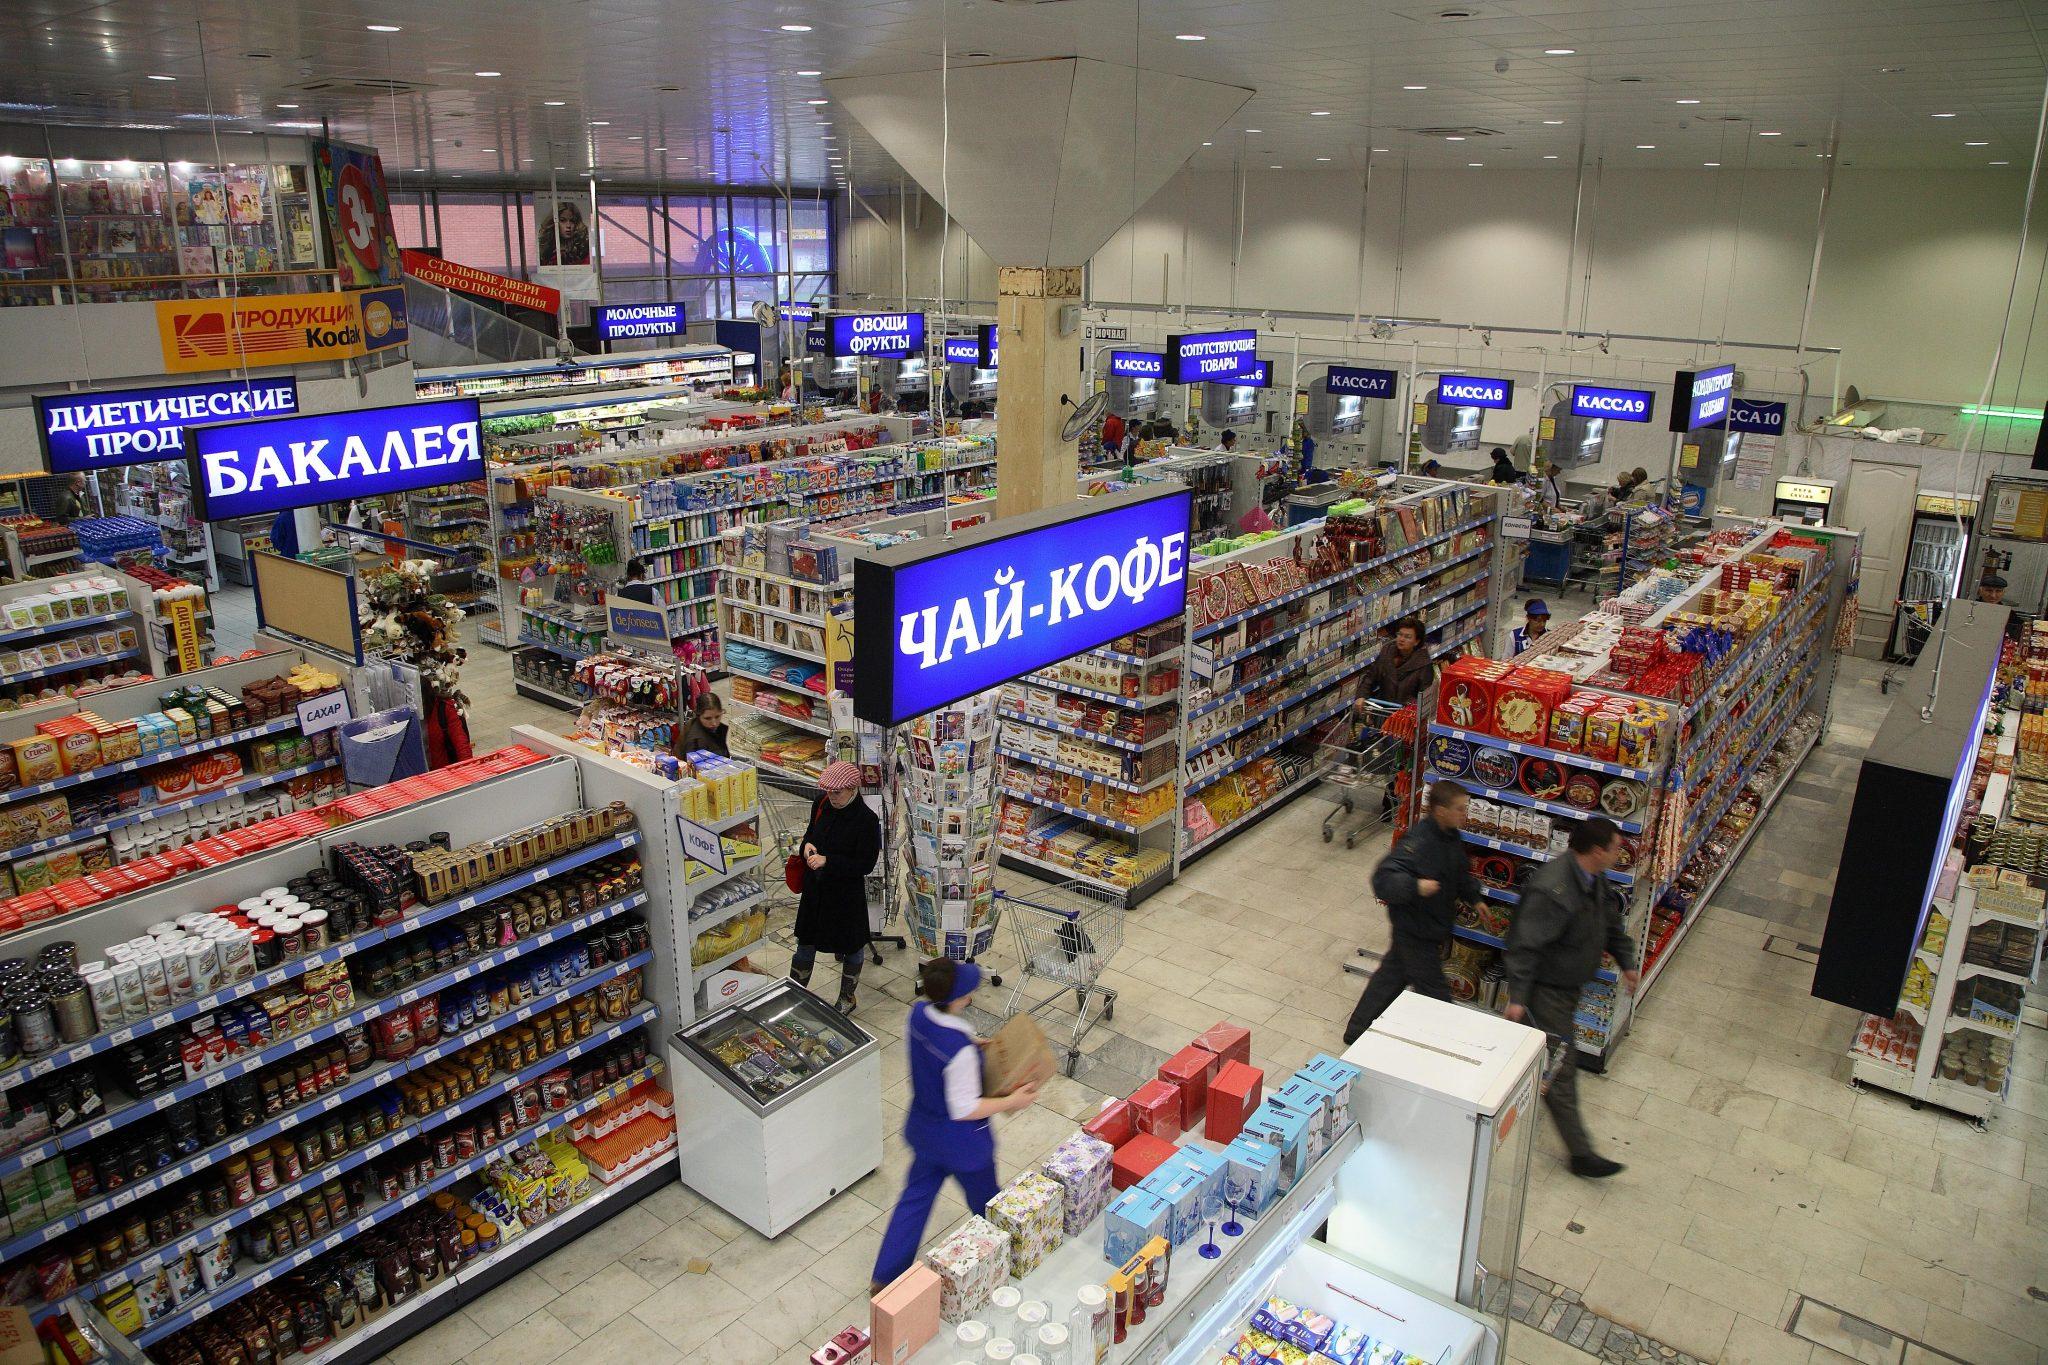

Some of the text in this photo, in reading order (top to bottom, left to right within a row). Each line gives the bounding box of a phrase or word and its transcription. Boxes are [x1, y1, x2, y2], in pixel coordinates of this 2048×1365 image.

[428, 258, 540, 296] СТАЛЬНЫЕ ДВЕРИ
[414, 267, 547, 309] НОВОГО ПОКОЛЕНИЯ
[231, 304, 354, 330] ПРОДУКЦИЯ
[605, 305, 677, 321] МОЛОЧНЫЕ
[608, 320, 676, 337] ПРОДУКТЫ
[852, 315, 908, 333] ОВОЩИ
[1086, 327, 1127, 340] СМОЧНАЯ
[305, 325, 361, 349] Kodak
[849, 334, 910, 354] ФРУКТЫ
[1180, 339, 1256, 357] СОПУТСТВУЮЩИЕ
[1200, 357, 1238, 373] ТОВАРЫ
[48, 386, 295, 435] ДИЕТИЧЕСКИЕ
[1729, 408, 1781, 425] ССА 10
[87, 426, 186, 458] ПРОД
[202, 421, 482, 498] БАКАЛЕЯ
[900, 532, 1185, 670] ЧАЙ-КОФЕ
[175, 605, 198, 672] ДИЕТИЧЕСКИ
[306, 703, 341, 723] САХАР
[24, 743, 53, 761] Cruesli
[66, 734, 94, 750] Cruesli
[689, 833, 716, 855] КОФЕ
